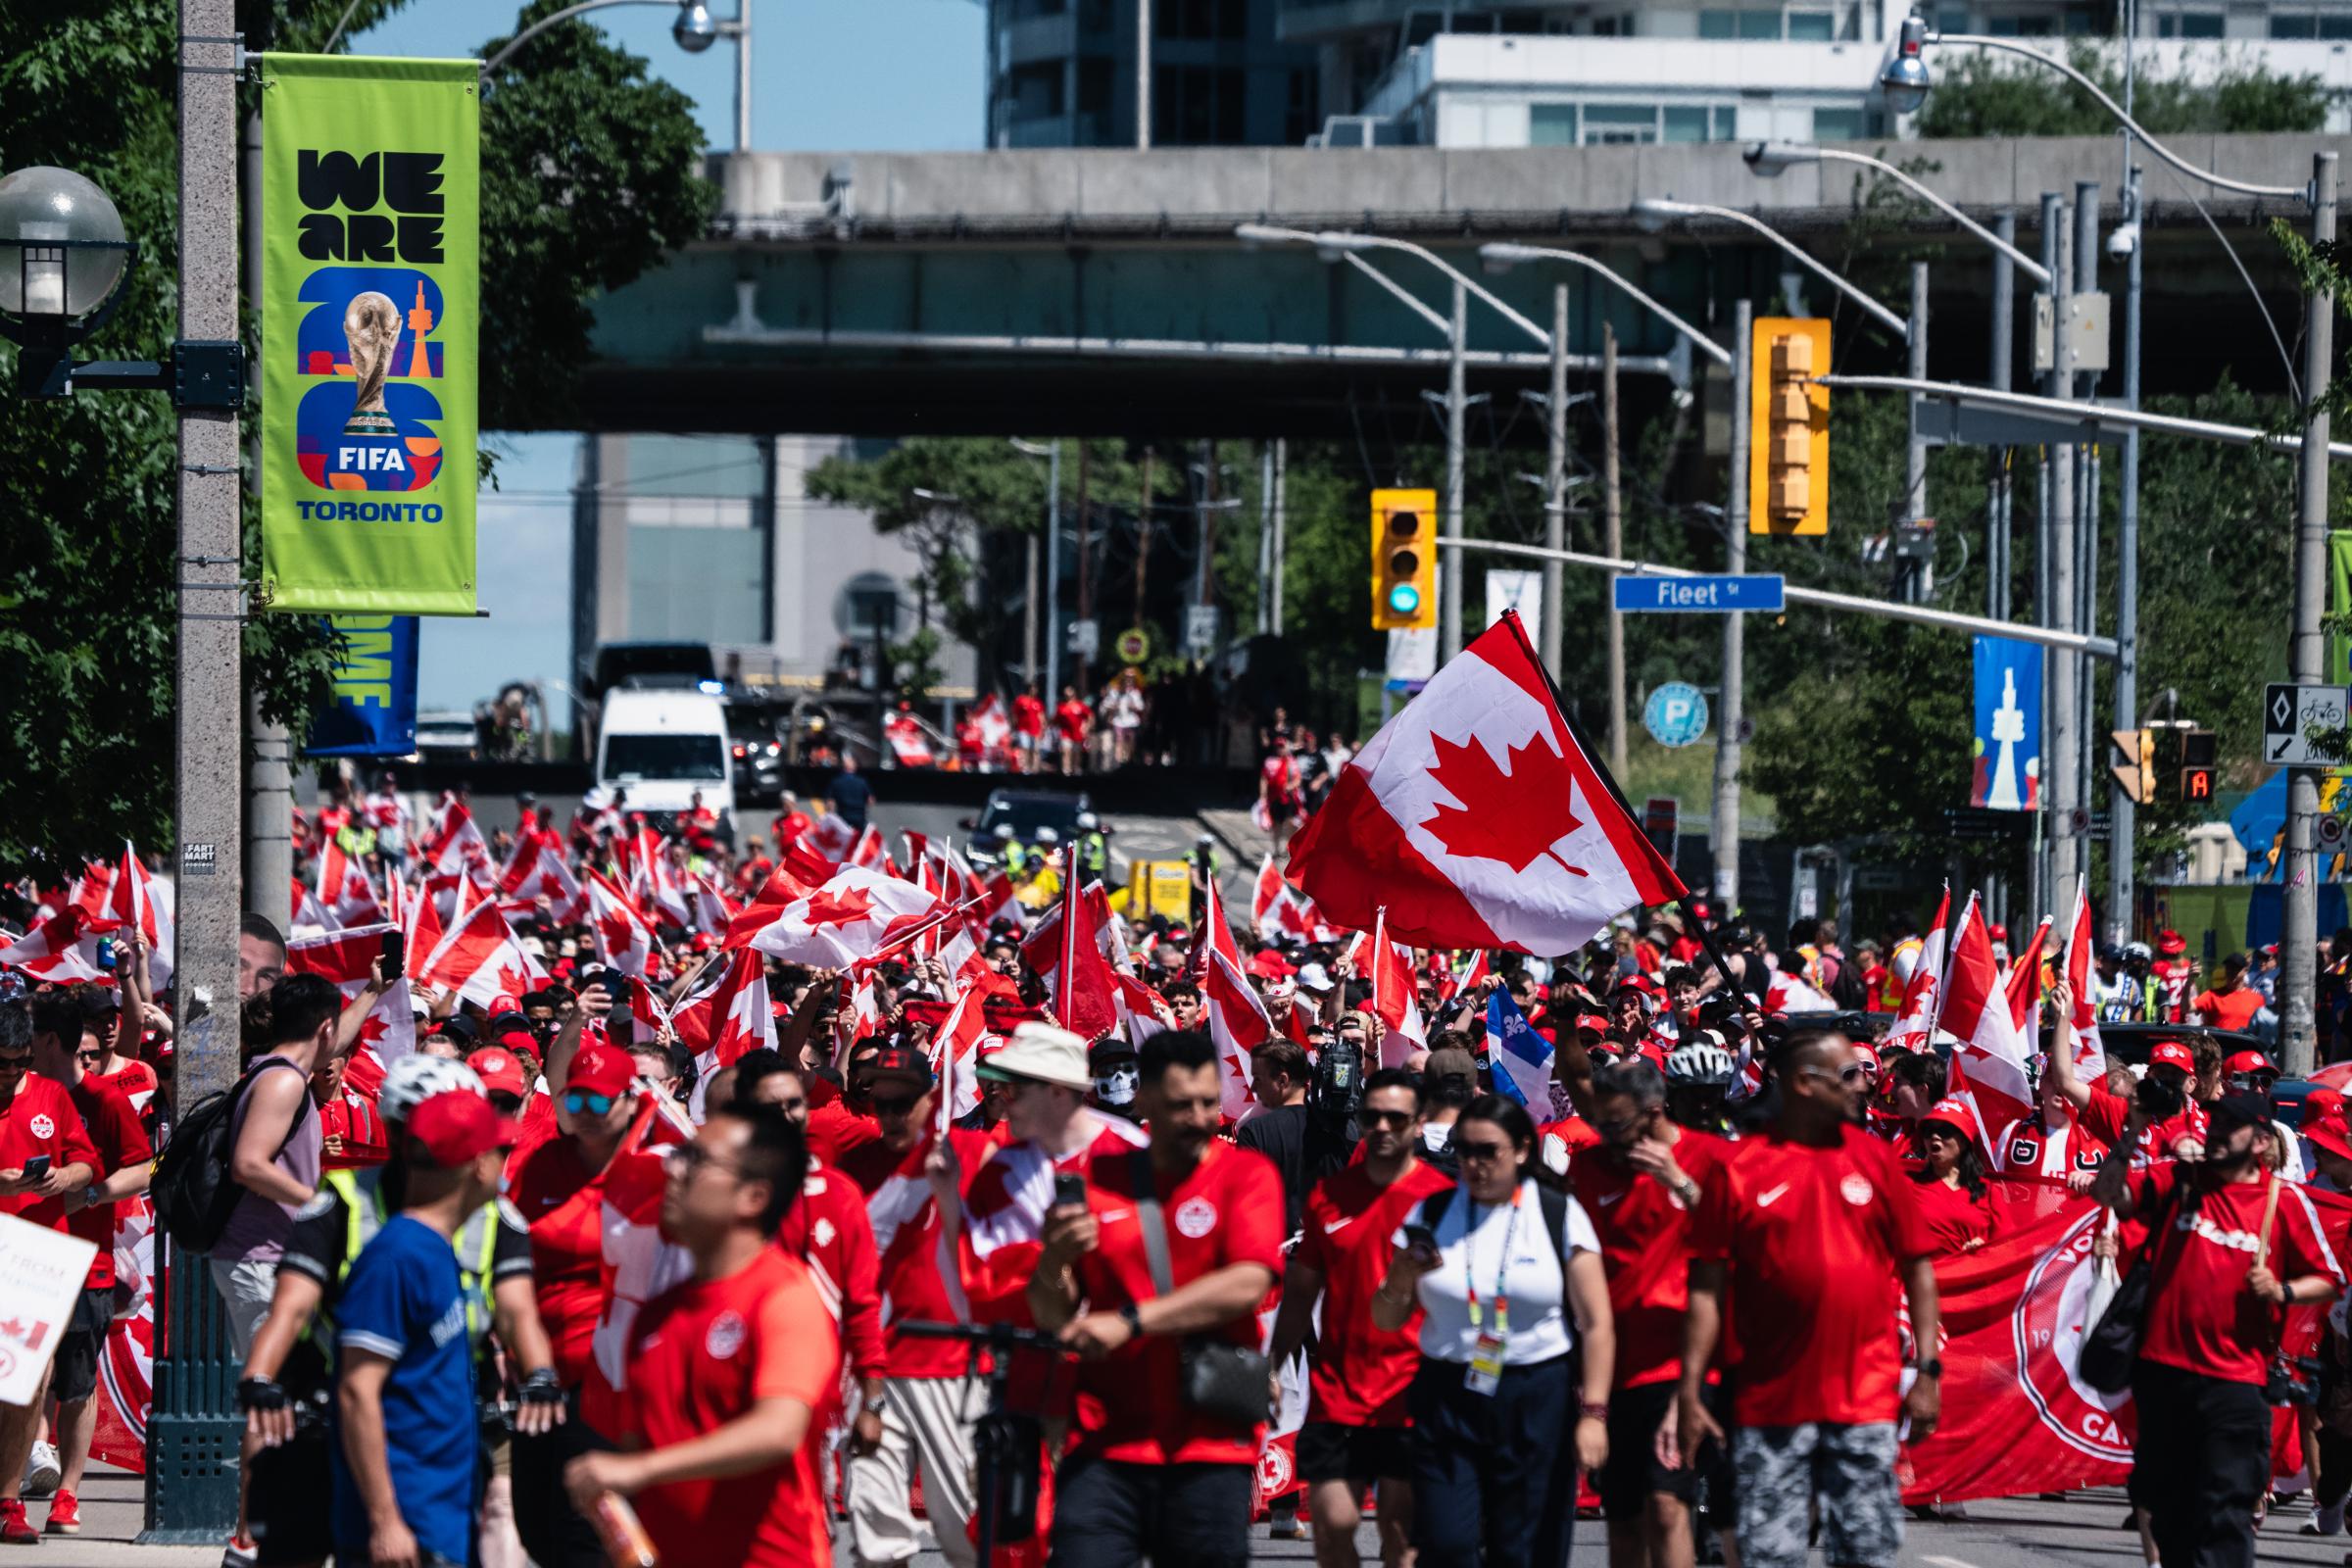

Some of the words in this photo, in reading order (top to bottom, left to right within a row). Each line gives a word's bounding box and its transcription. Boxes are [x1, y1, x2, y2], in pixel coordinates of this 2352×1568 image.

[298, 149, 445, 215] WE
[339, 447, 406, 471] FIFA
[297, 501, 444, 523] TORONTO
[1658, 581, 1718, 606] Fleet
[1666, 699, 1691, 724] P
[184, 852, 215, 860] MART
[187, 844, 215, 853] FART
[2082, 1412, 2130, 1446] CA
